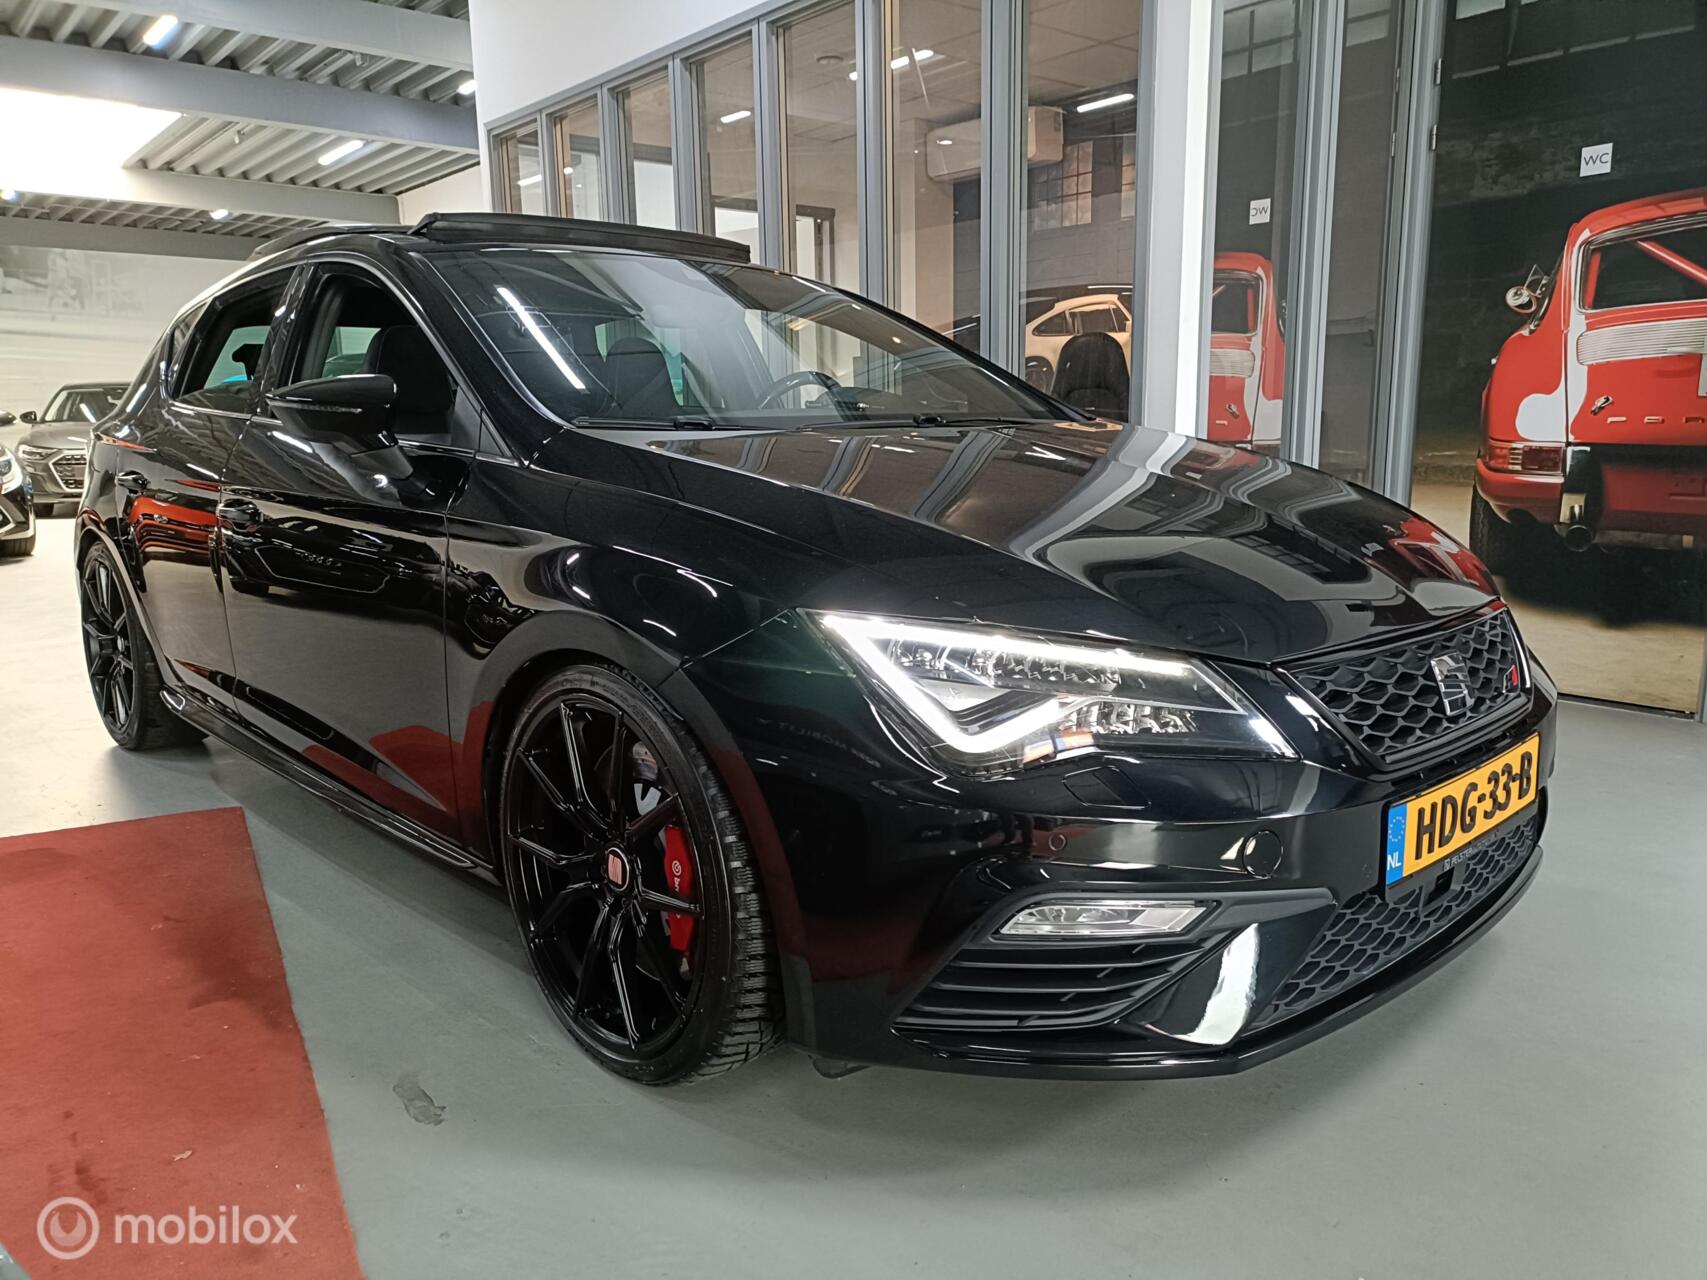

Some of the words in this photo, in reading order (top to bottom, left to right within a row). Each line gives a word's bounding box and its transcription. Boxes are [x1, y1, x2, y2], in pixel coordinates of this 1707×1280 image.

[1584, 152, 1610, 166] WC
[1415, 751, 1533, 861] HDG-33-B
[1386, 852, 1402, 871] NL
